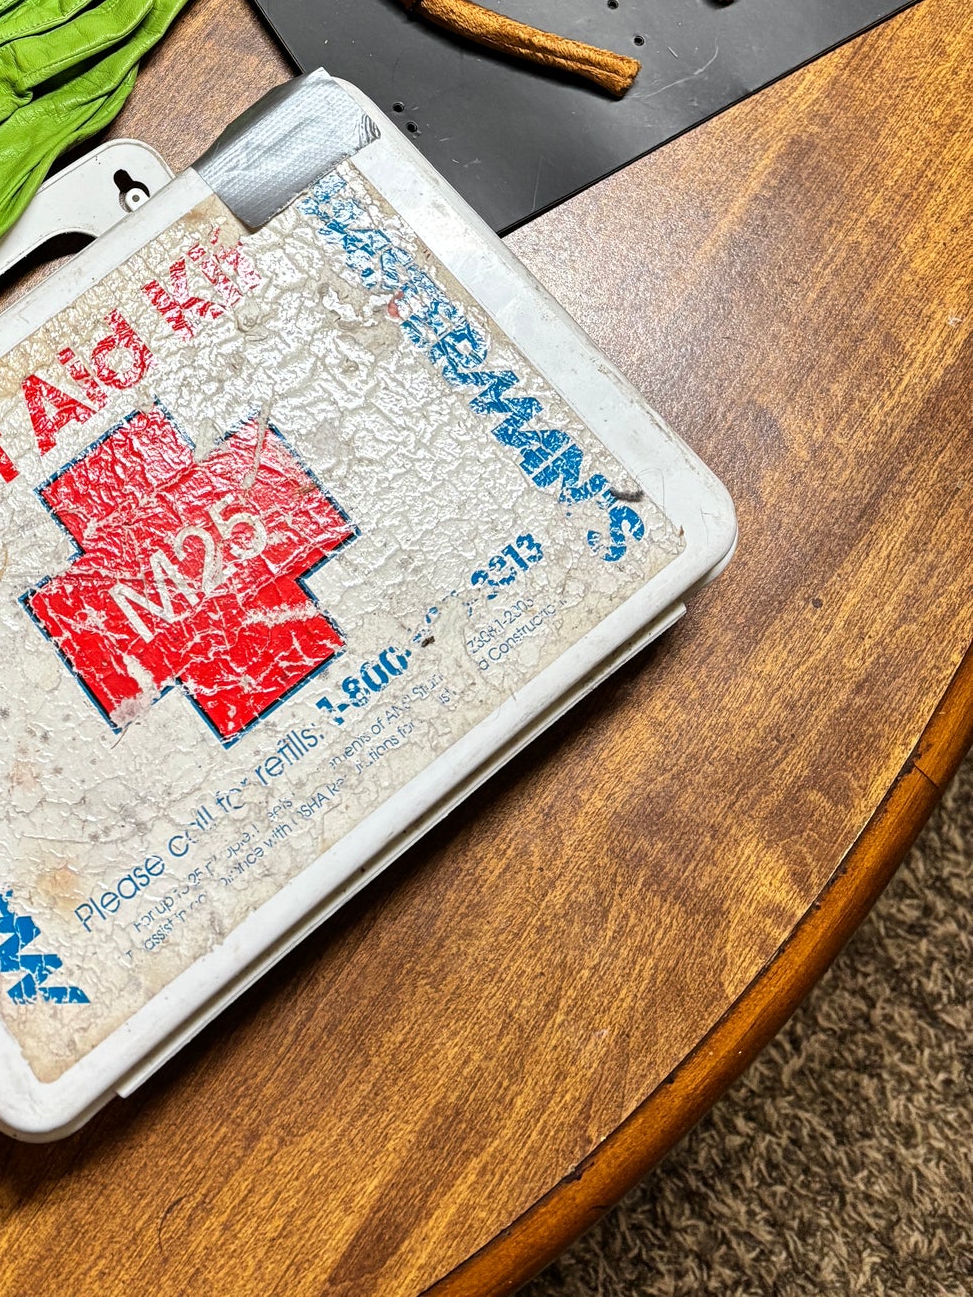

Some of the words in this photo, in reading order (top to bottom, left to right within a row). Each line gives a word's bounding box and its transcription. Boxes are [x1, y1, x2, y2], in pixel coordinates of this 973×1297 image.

[21, 309, 155, 456] Aid
[141, 226, 262, 341] Kit
[108, 493, 267, 644] M25
[74, 855, 165, 933] Please
[255, 722, 325, 787] refills:
[155, 896, 175, 914] up
[188, 867, 204, 888] 25
[371, 717, 385, 735] of
[144, 918, 175, 952] assist
